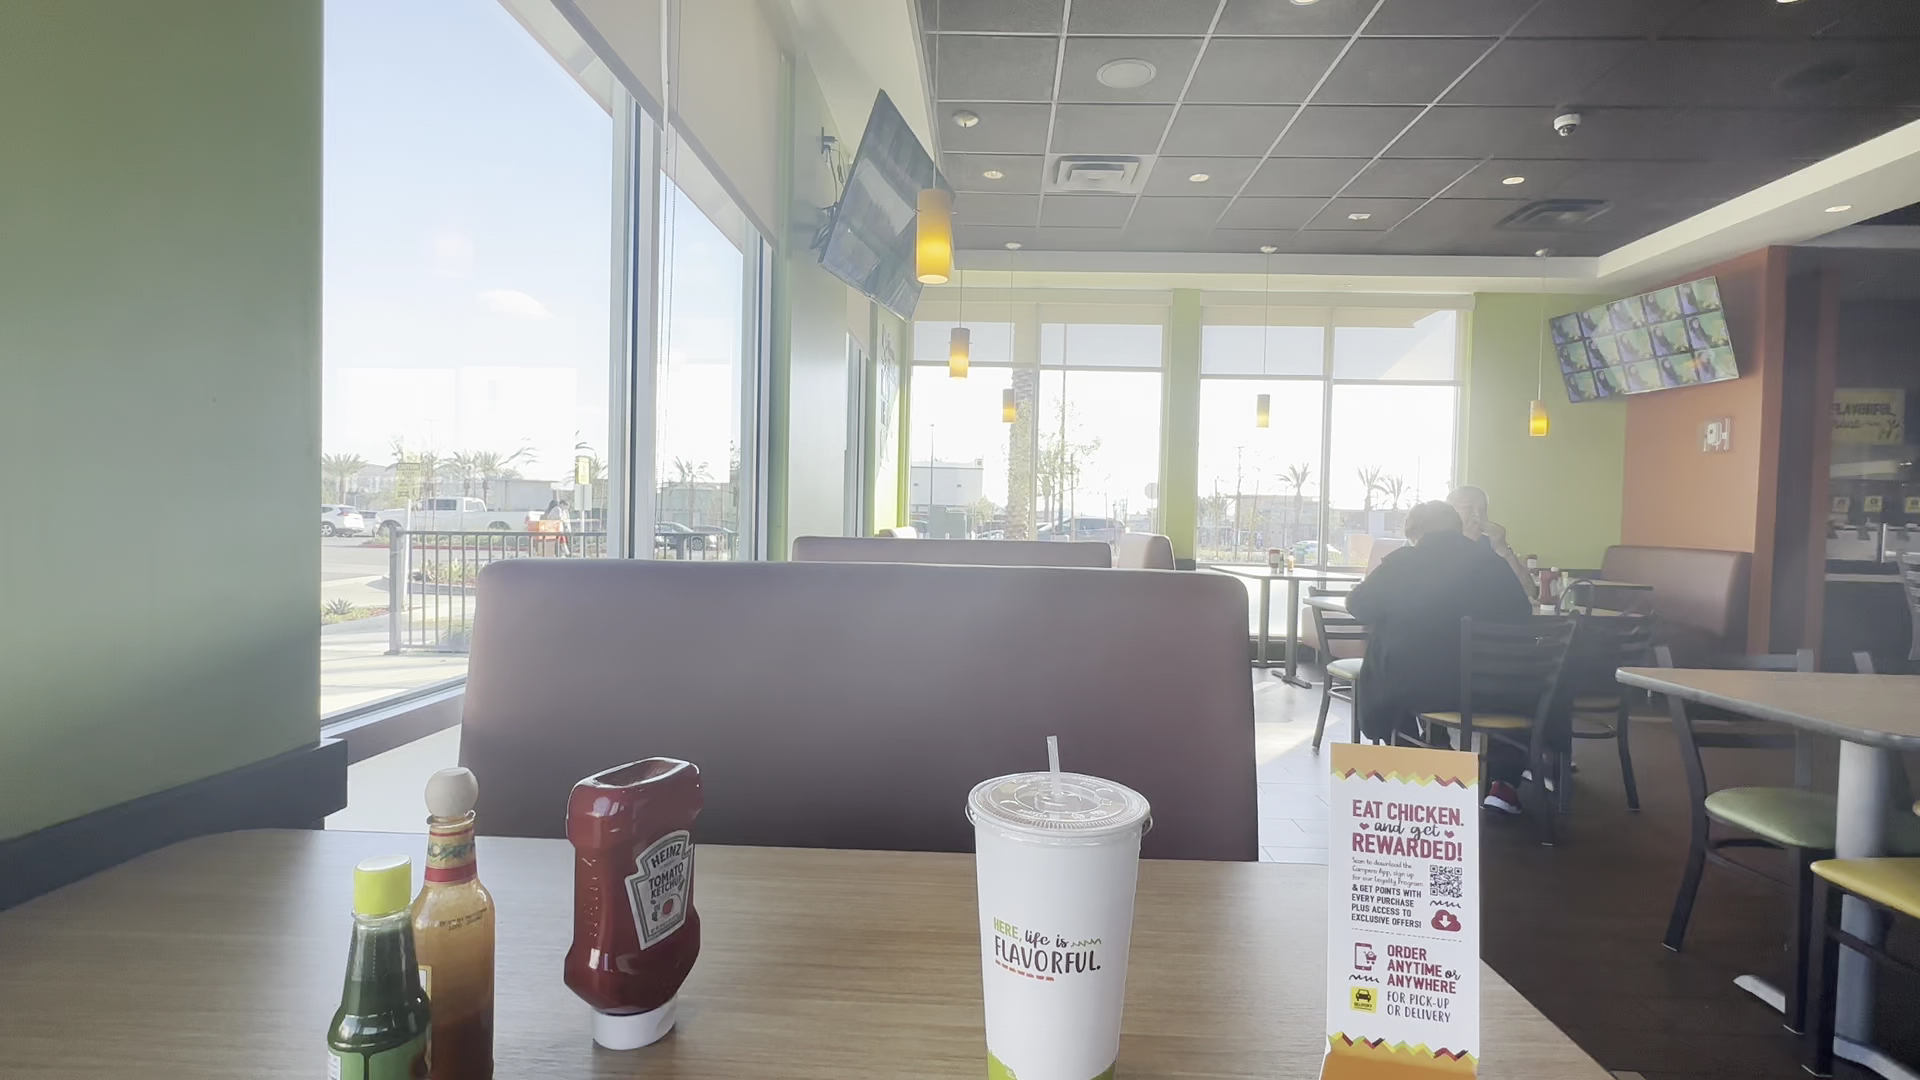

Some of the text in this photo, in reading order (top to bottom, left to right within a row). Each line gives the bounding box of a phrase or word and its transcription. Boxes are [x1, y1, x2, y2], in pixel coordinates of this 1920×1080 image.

[1352, 799, 1464, 827] EAT CHICKEN.
[1374, 820, 1441, 841] and get
[650, 843, 682, 869] HEINZ
[1352, 832, 1463, 862] REWARDED!
[1352, 856, 1365, 864] Scan
[1373, 859, 1402, 868] download
[1352, 865, 1378, 875] Campero
[1393, 870, 1405, 879] sign
[648, 862, 684, 890] TOMATO
[650, 874, 684, 899] KETCHUP
[1351, 883, 1422, 898] & GET POINTS WITH
[1351, 894, 1414, 907] EVERY PURCHASE
[1351, 904, 1412, 917] PLUS ACCESS TO
[1351, 913, 1422, 928] EXCLUSIVE OFFERS!
[993, 916, 1069, 949] HERE, life is
[994, 935, 1101, 975] FLAVORFUL.
[1387, 944, 1427, 961] ORDER
[1386, 959, 1461, 981] ANYTIME or
[1386, 973, 1457, 994] ANYWHERE
[1387, 990, 1450, 1009] FOR PICK-UP
[1387, 1004, 1451, 1023] OR DELIVERY
